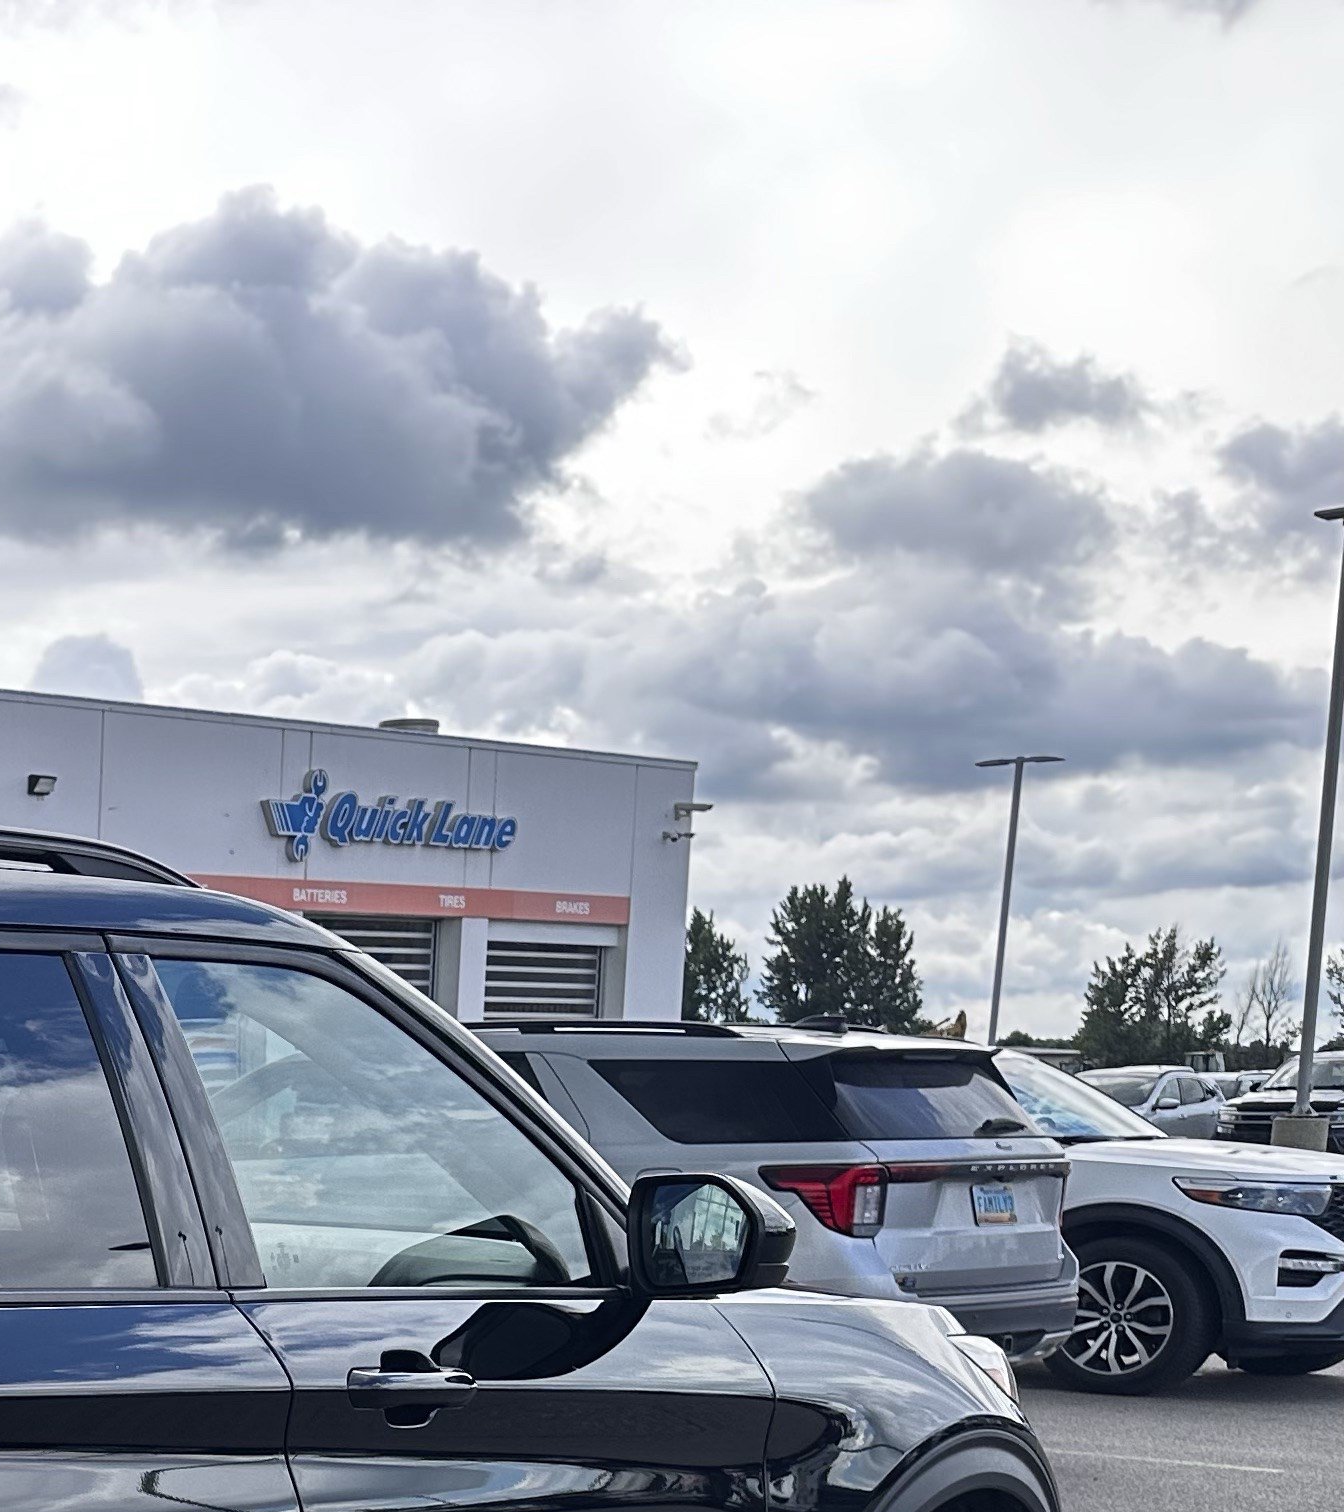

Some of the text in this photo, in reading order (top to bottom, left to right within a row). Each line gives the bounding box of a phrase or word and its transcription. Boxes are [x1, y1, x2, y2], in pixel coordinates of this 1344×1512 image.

[325, 791, 517, 850] Quick Lane
[292, 887, 348, 905] BATTERIES
[438, 894, 466, 909] TIRES
[555, 900, 590, 915] BRAKES
